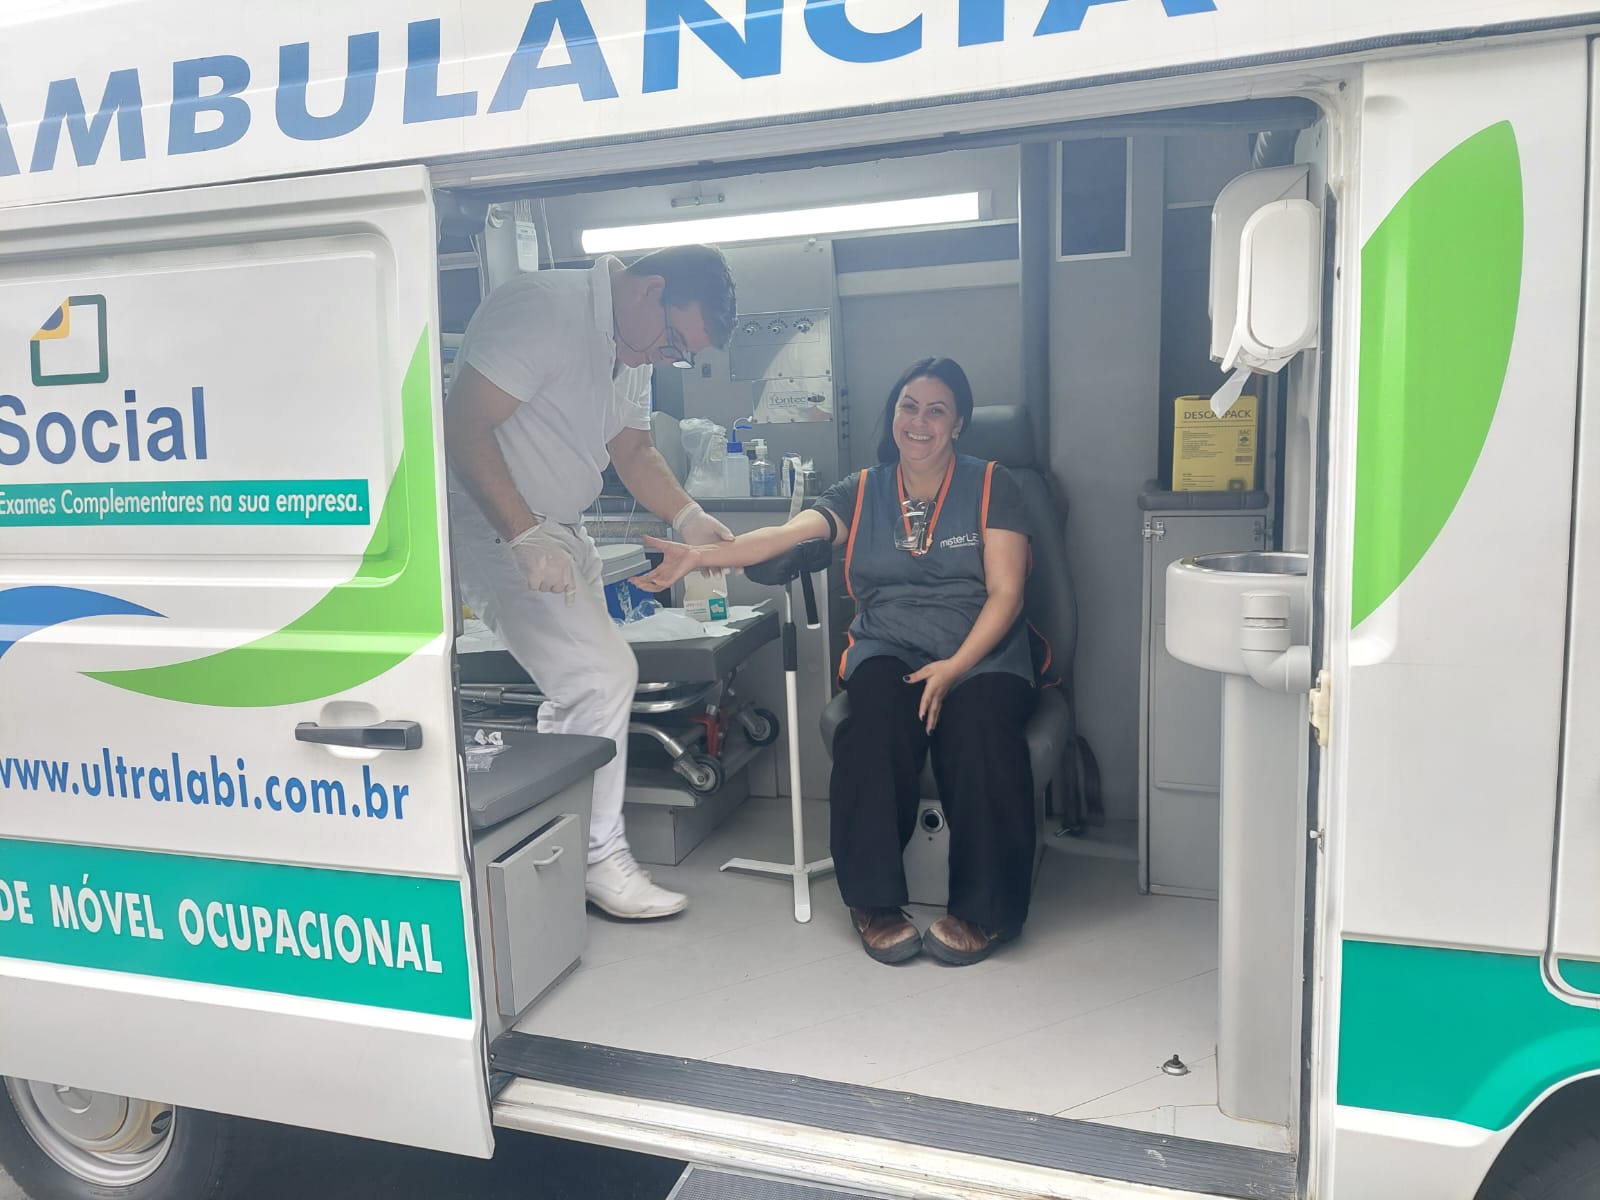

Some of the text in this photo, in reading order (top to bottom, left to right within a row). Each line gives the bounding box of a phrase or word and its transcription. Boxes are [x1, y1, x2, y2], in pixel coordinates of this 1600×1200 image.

[0, 386, 207, 466] Social
[1183, 410, 1252, 420] DESCAPACK
[0, 488, 363, 520] Exames Complementares na sua empresa.
[50, 874, 164, 940] MÓVEL
[178, 898, 443, 973] OCUPACIONAL
